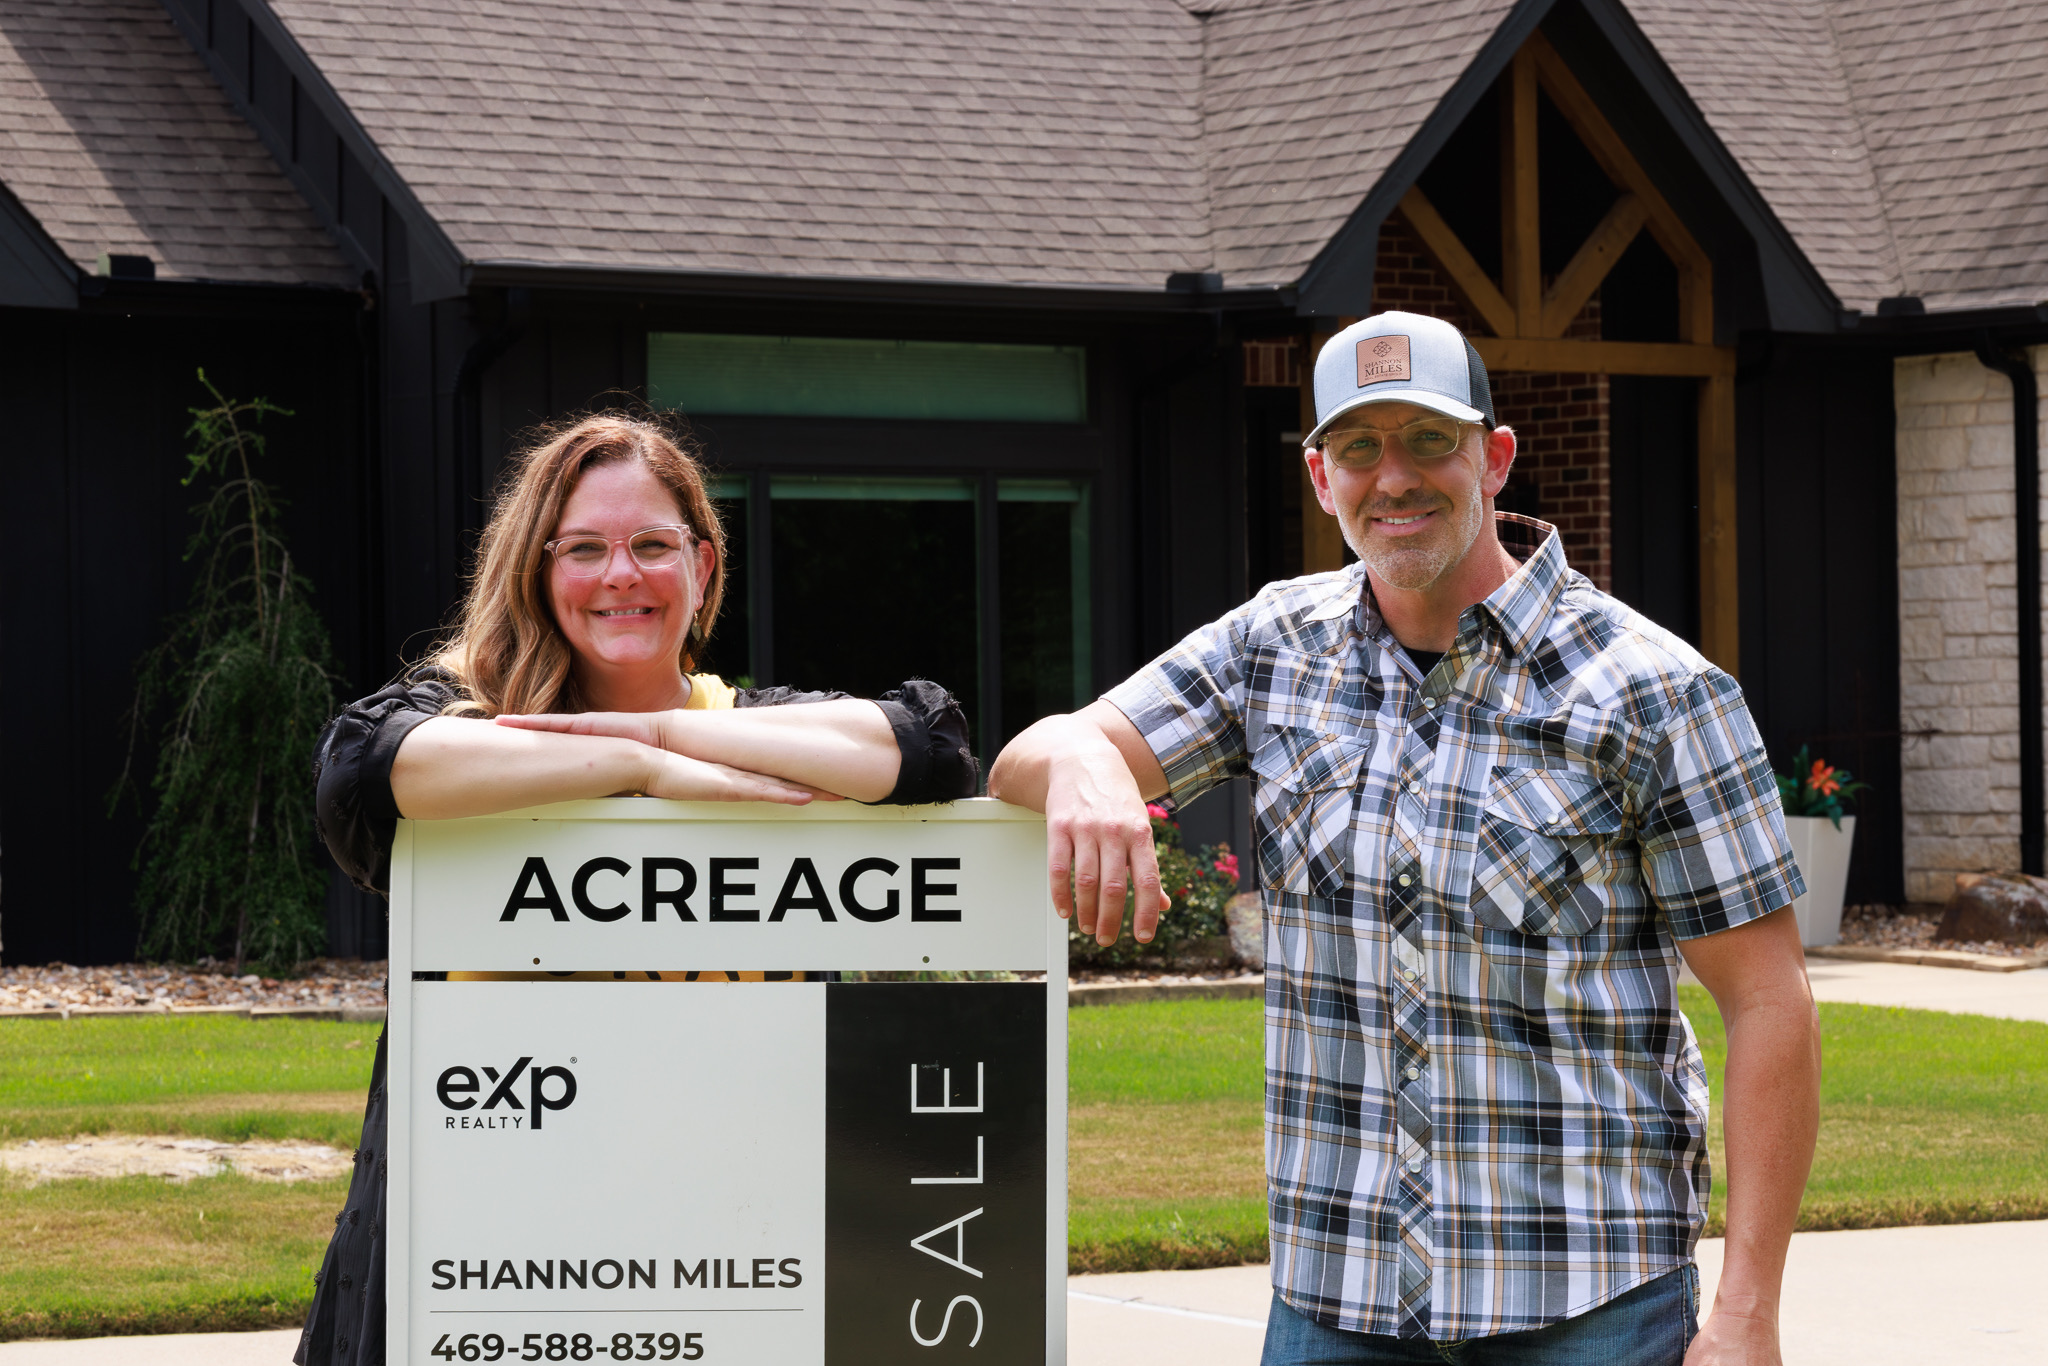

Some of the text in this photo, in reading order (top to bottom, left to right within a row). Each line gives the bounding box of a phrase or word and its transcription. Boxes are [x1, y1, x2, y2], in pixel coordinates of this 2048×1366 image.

[1364, 359, 1402, 369] SHANNON
[1364, 364, 1403, 377] MILES
[499, 857, 962, 923] ACREAGE
[445, 1116, 523, 1129] REALTY
[910, 1061, 984, 1348] SALE
[431, 1258, 803, 1290] SHANNON MILES
[430, 1332, 704, 1361] 469-588-8395
